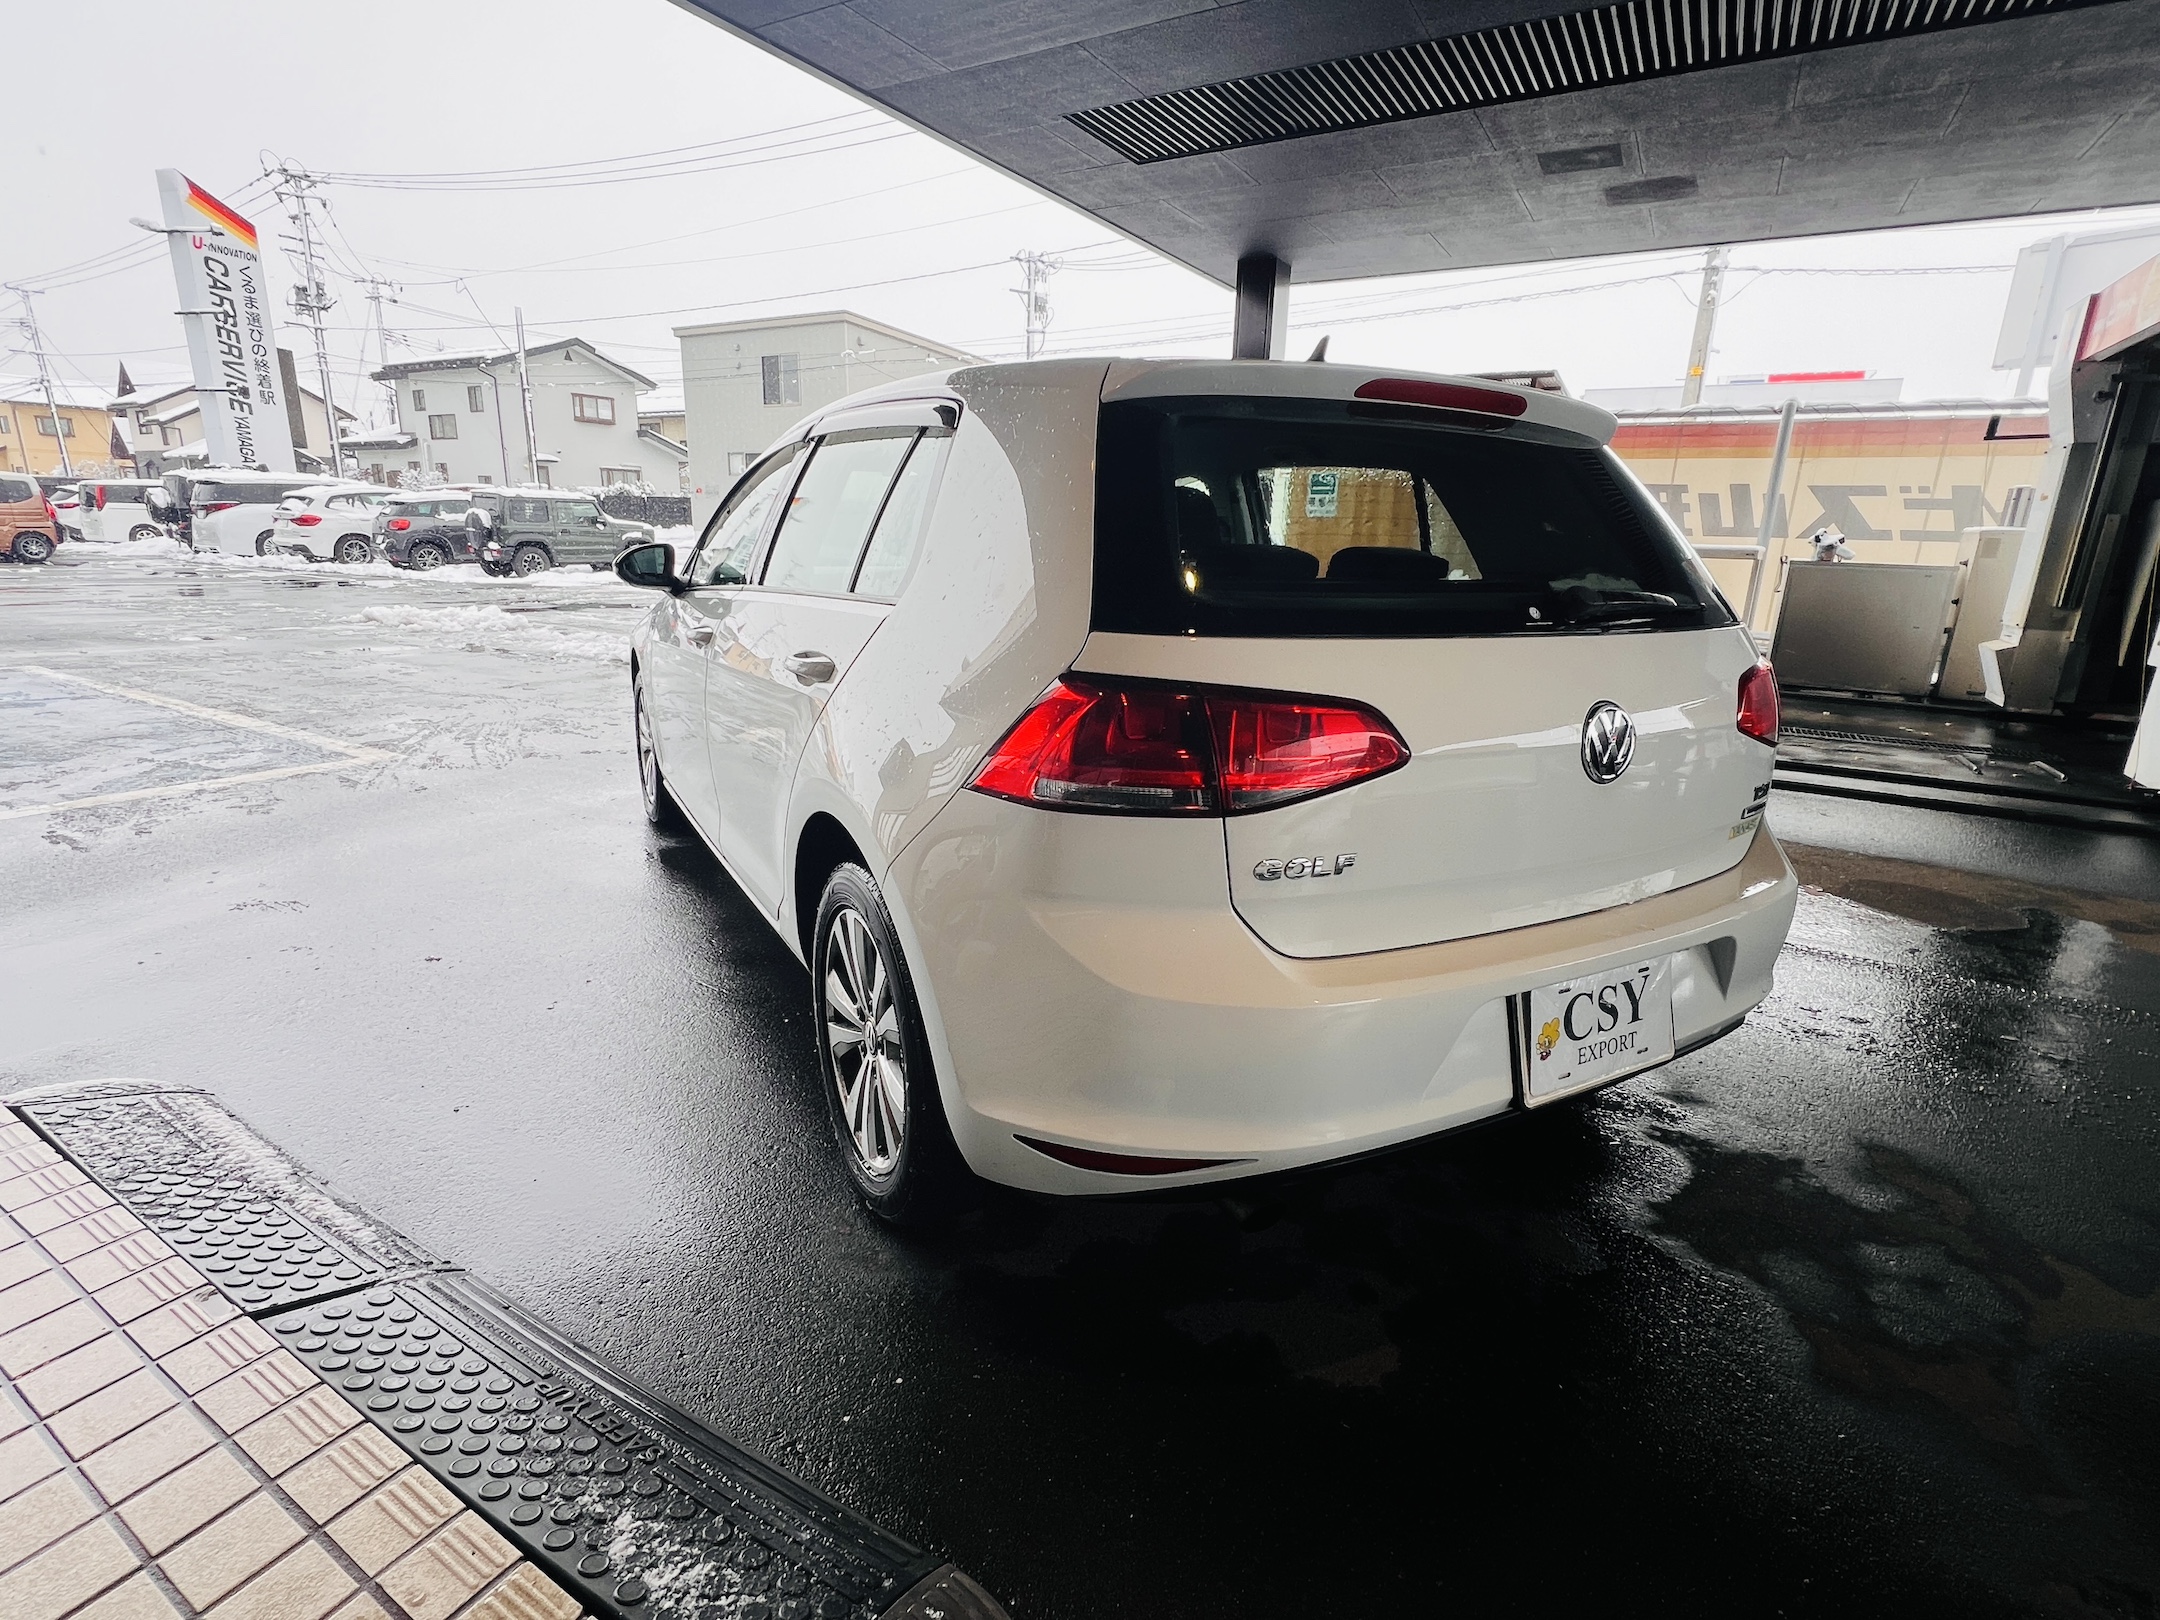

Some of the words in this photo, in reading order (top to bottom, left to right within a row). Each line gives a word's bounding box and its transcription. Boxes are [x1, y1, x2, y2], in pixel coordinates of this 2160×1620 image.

[239, 266, 276, 405] くるま選びの終着駅
[1253, 852, 1358, 881] GOLF
[1563, 974, 1650, 1041] CSY
[1577, 1030, 1638, 1065] EXPORT
